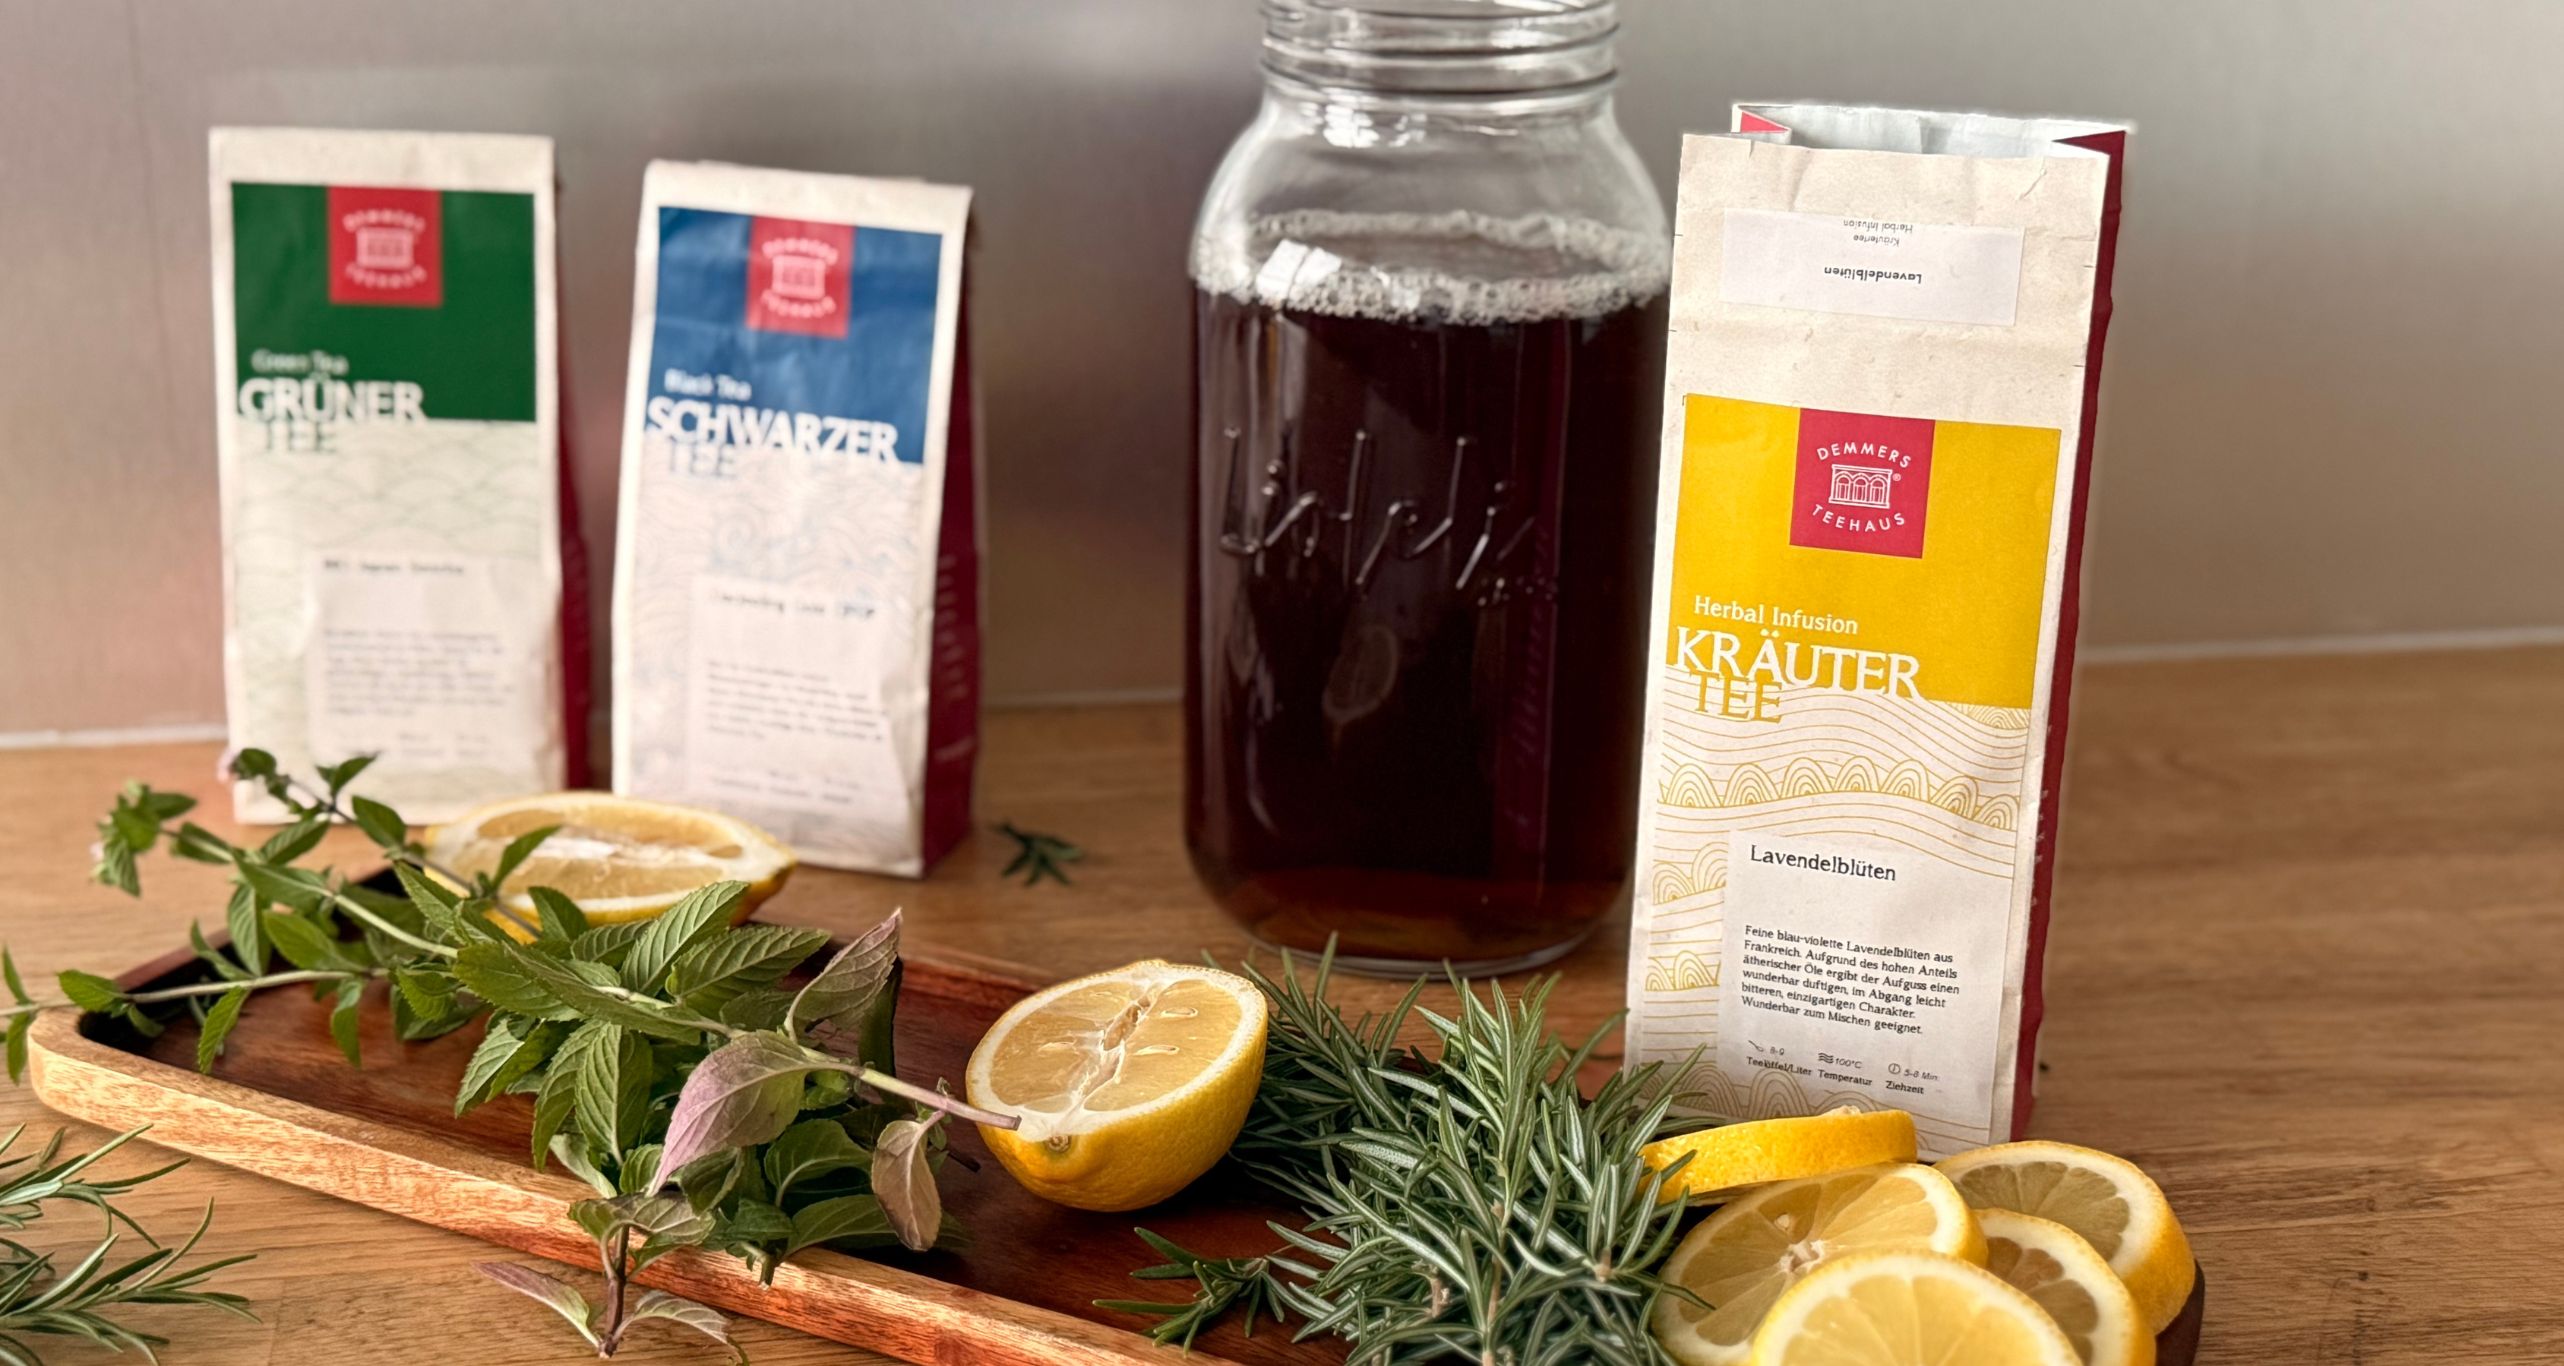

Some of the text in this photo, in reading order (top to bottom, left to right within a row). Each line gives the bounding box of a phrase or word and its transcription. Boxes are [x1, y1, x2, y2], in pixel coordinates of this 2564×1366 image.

[1843, 219, 1914, 234] Herbal Infusion
[1823, 266, 1922, 284] Lavendelblüten
[238, 372, 429, 424] GRÜNER
[647, 396, 900, 463] SCHWARZER
[1816, 441, 1912, 469] DEMMERS
[1811, 503, 1906, 533] TEEHAUS
[1694, 595, 1859, 636] Herbal Infusion
[1676, 626, 1926, 701] KRÄUTER
[1690, 670, 1783, 724] TEE
[1750, 844, 1897, 882] Lavendelblüten
[1744, 939, 1958, 979] Frankreich. Aufgrund des hohen Anteils
[1745, 924, 1954, 963] Feine blau-violette Lavendelblüten aus
[1743, 954, 1960, 995] ätherischer Öle ergibt der Aufguss einen
[1743, 970, 1800, 986] wunderbar
[1852, 986, 1866, 997] im
[1868, 989, 1913, 1007] Abgang
[1915, 994, 1946, 1008] leicht
[1741, 981, 1916, 1019] bitteren, einzigartigen Charakter.
[1741, 995, 1923, 1035] Wunderbar zum Mischen geeignet.
[1817, 1069, 1873, 1086] Temperatur
[1885, 1080, 1925, 1095] Ziehzeit
